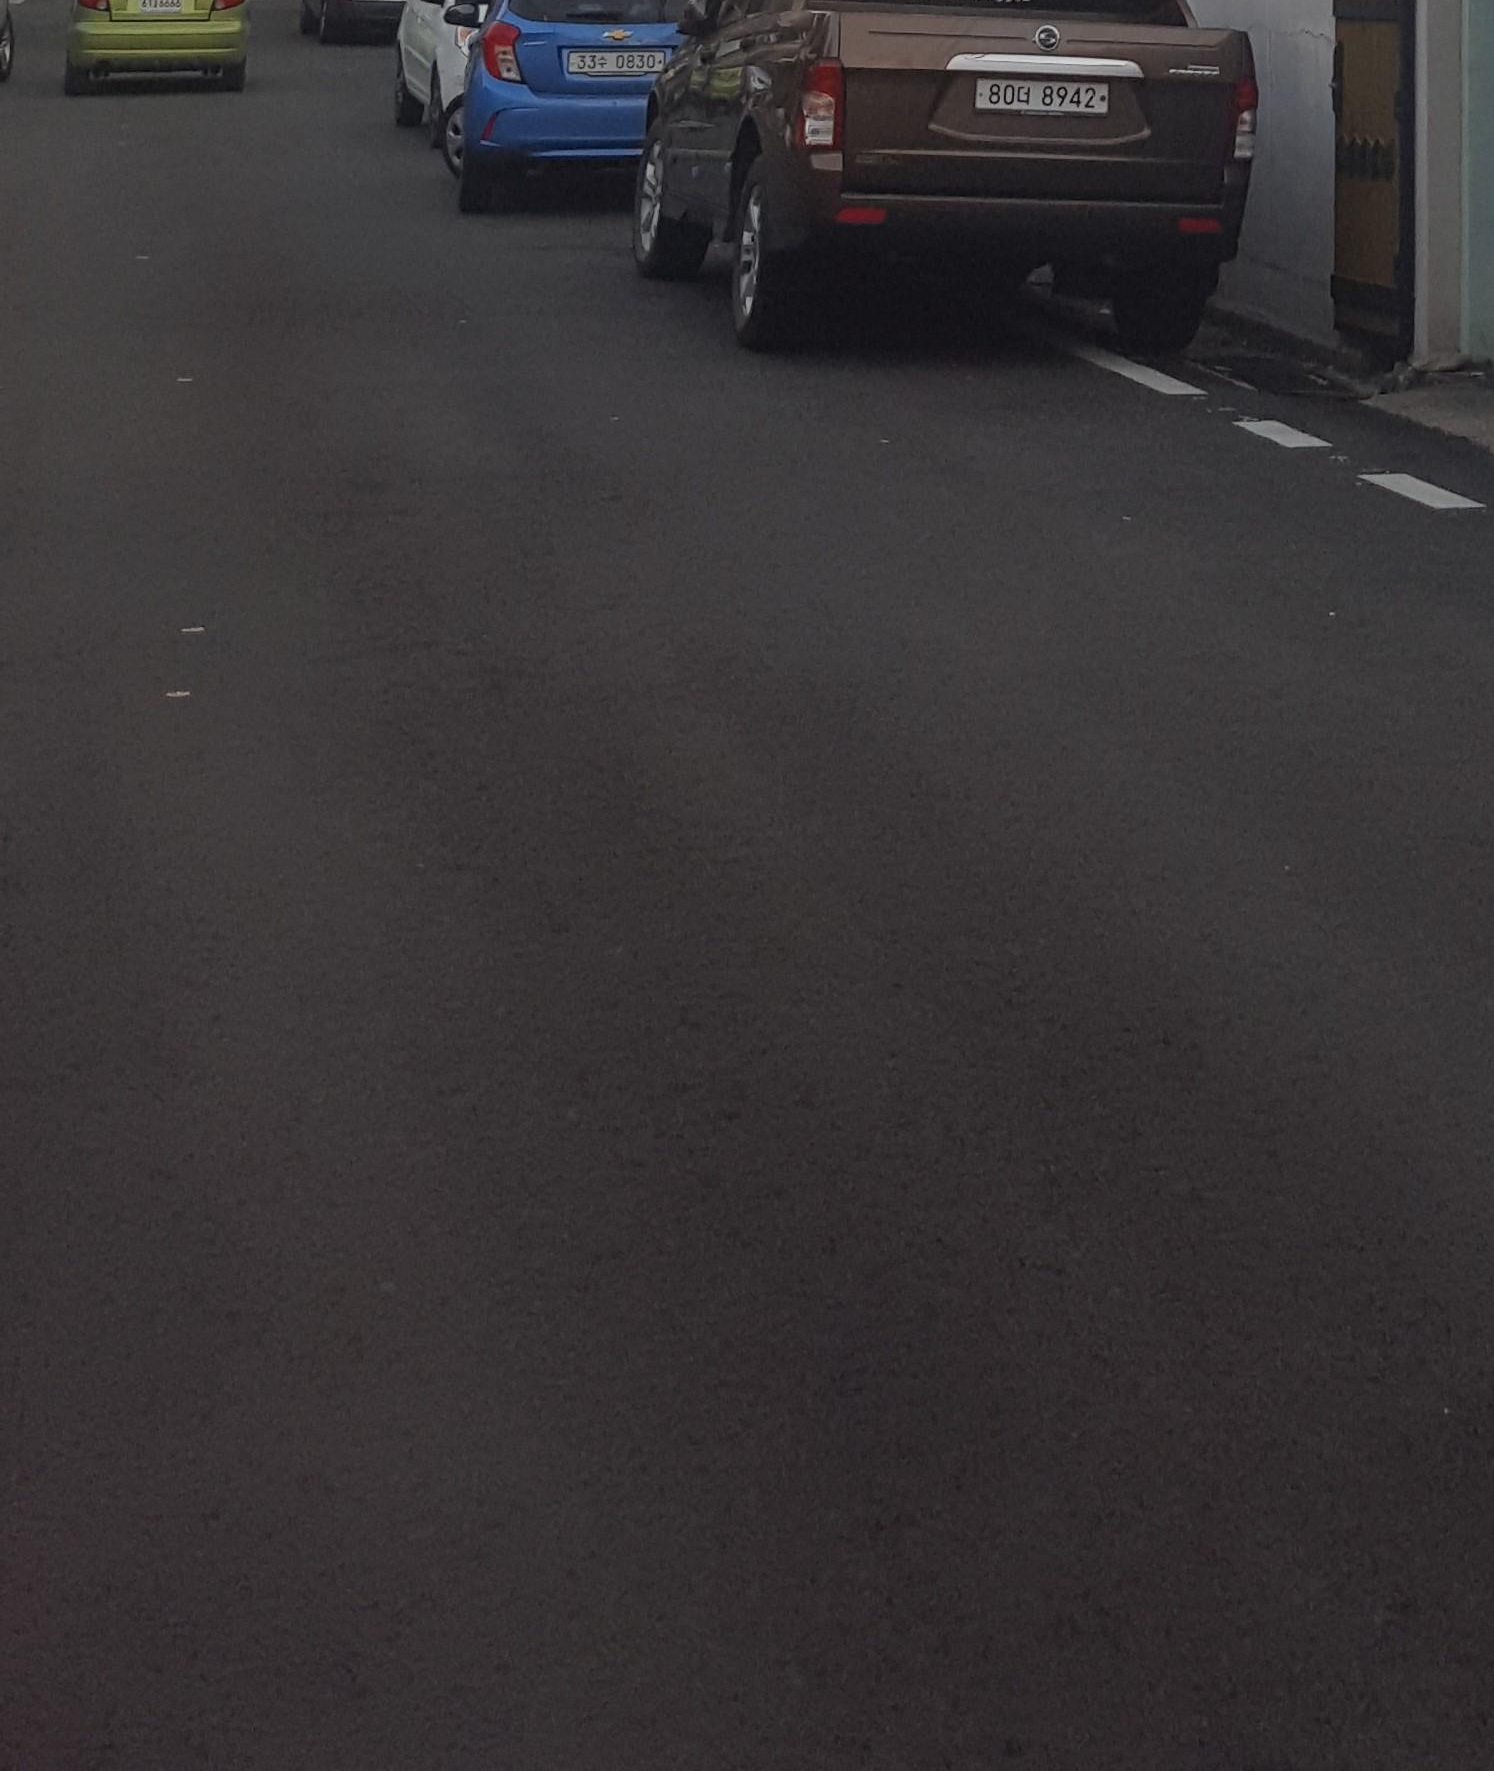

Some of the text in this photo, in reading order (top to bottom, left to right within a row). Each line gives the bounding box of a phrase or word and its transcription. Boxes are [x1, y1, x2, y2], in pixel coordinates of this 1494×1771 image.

[616, 54, 656, 69] 0830
[988, 83, 1097, 109] 80더 8942
